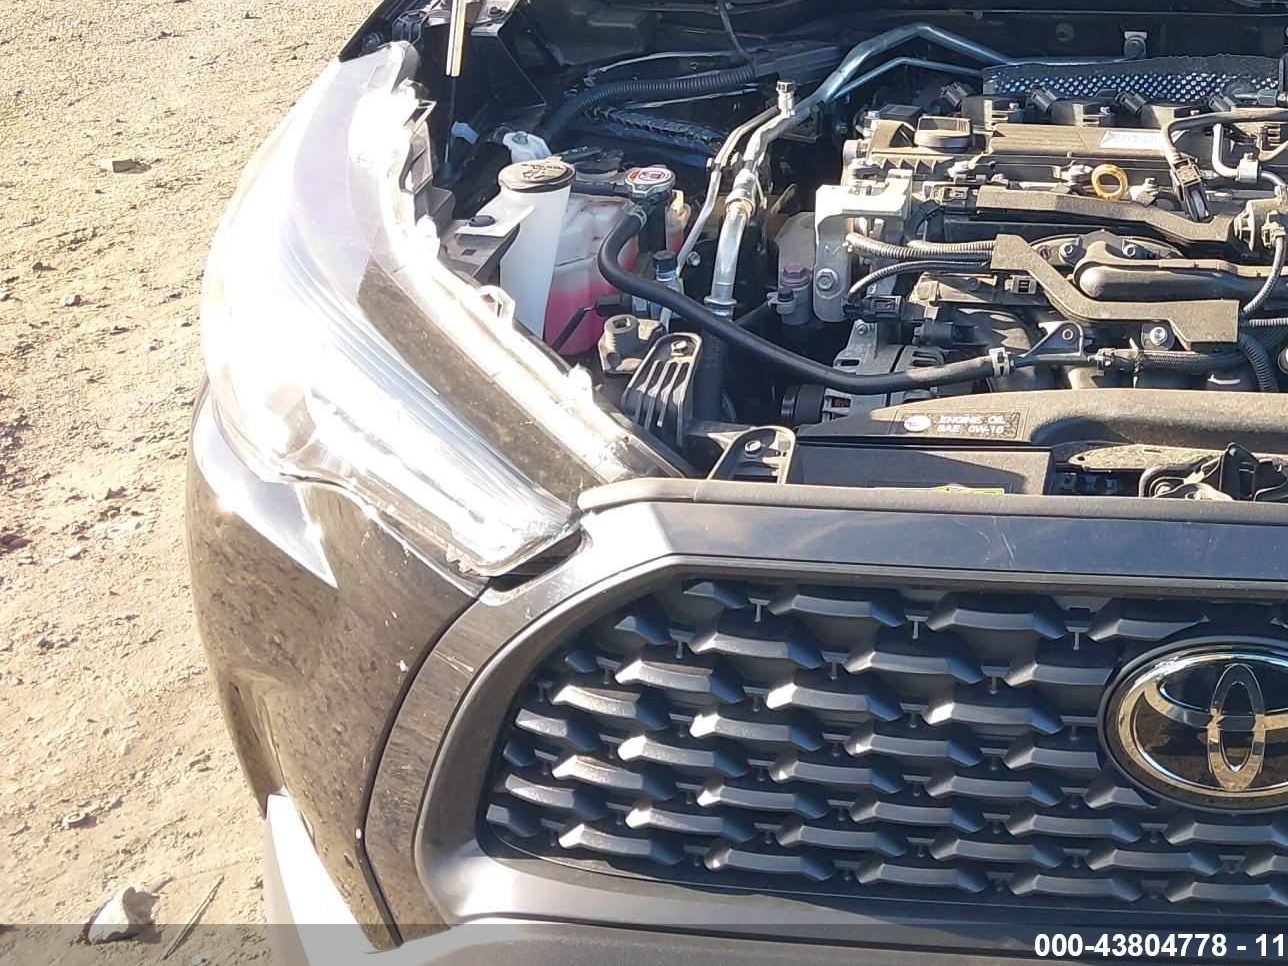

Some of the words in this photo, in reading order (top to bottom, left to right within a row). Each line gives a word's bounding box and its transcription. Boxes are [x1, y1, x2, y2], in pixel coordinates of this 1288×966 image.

[938, 414, 983, 424] ENGINE
[987, 415, 1007, 425] OIL
[936, 424, 961, 433] SAE
